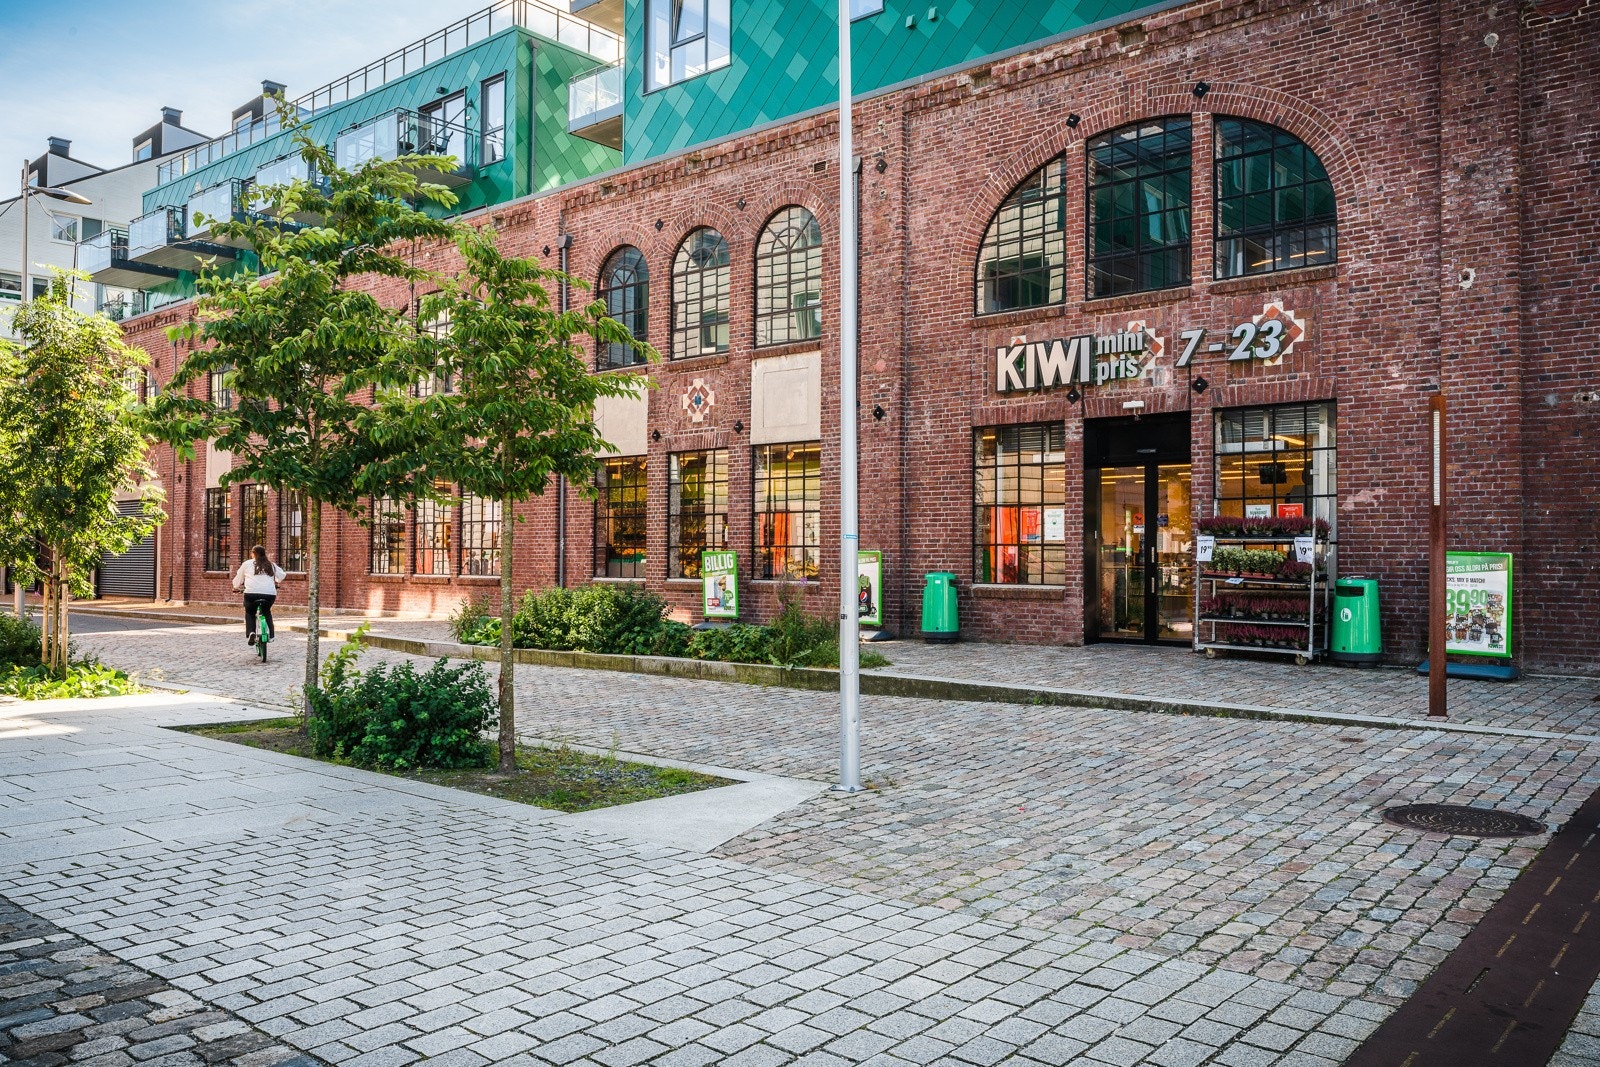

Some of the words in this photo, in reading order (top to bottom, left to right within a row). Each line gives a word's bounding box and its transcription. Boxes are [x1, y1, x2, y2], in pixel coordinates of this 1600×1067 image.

[1097, 326, 1146, 355] mini
[996, 336, 1092, 393] KIWI
[1097, 354, 1140, 386] pris
[705, 554, 734, 572] BILLIG
